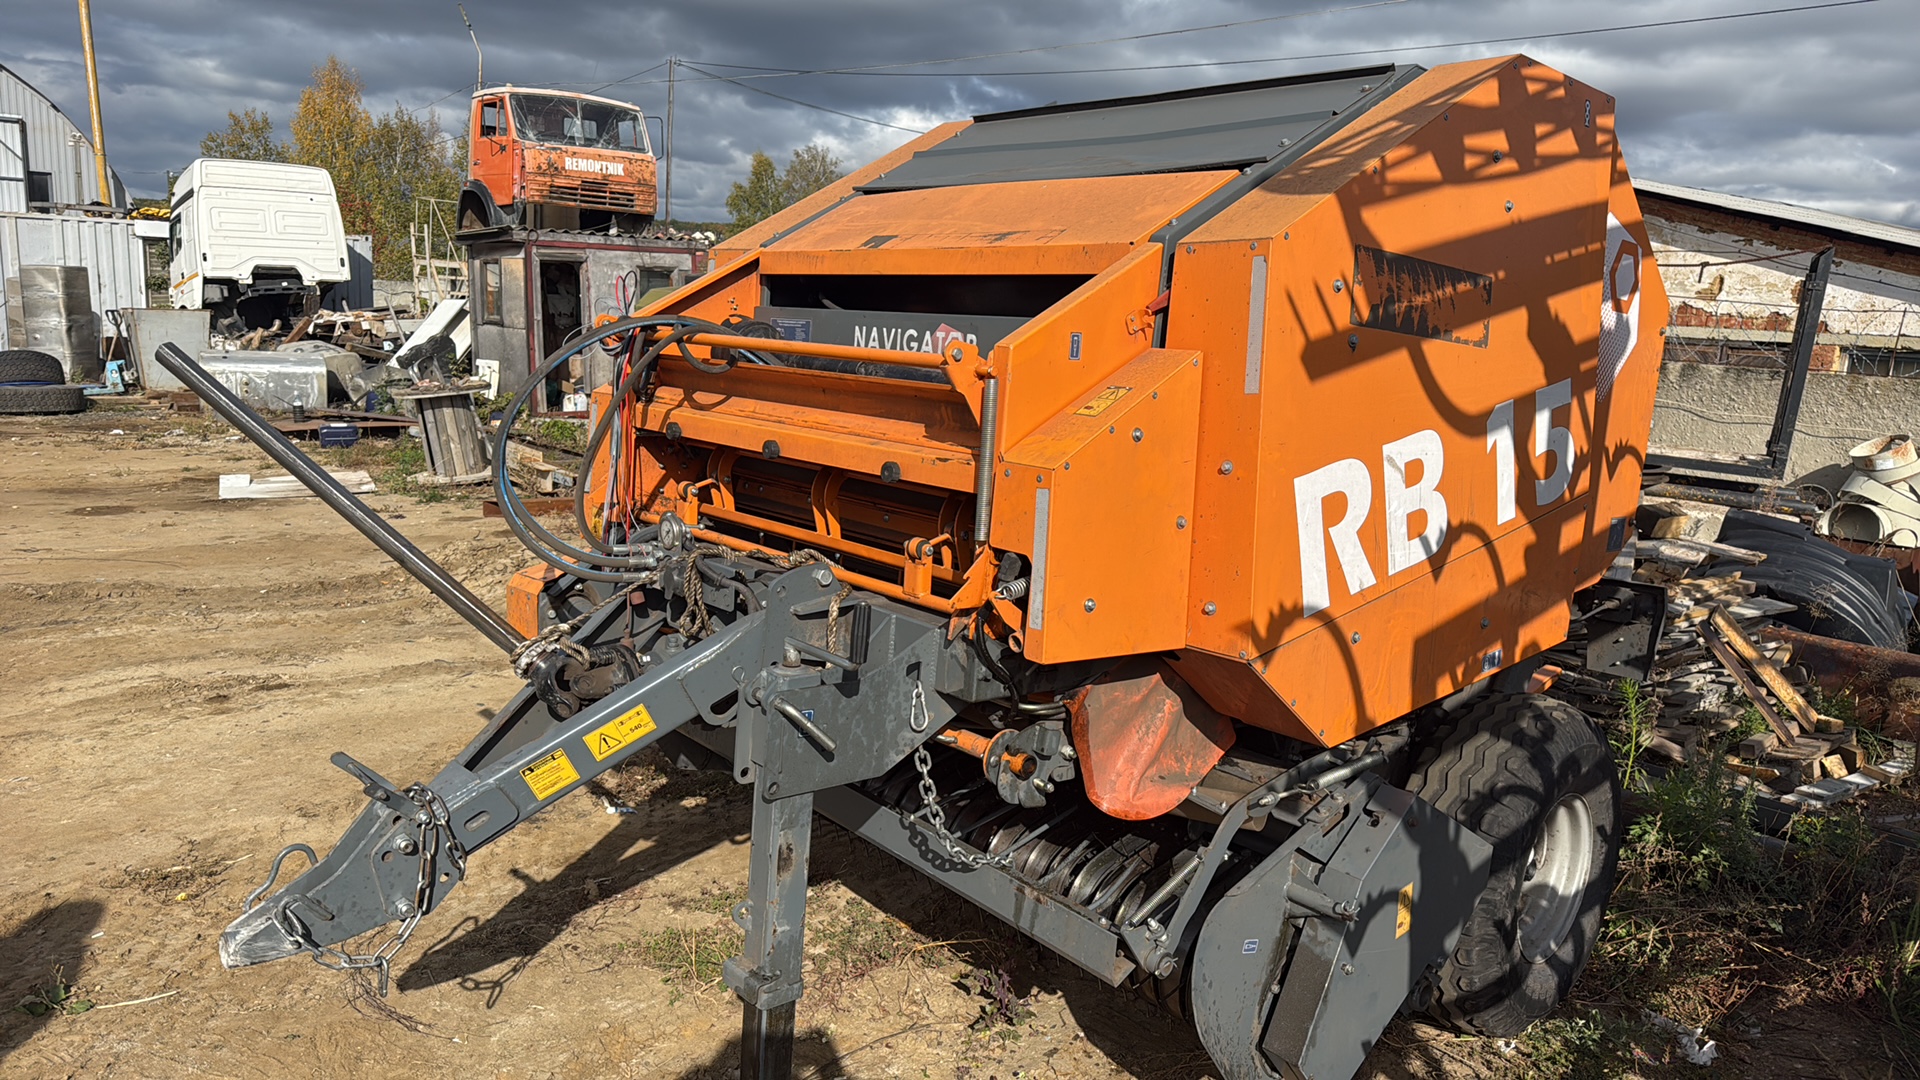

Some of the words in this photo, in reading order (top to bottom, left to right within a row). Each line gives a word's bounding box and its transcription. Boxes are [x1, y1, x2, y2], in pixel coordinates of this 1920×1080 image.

[1293, 429, 1448, 618] RB
[1486, 378, 1575, 526] 15
[629, 723, 643, 734] 540
